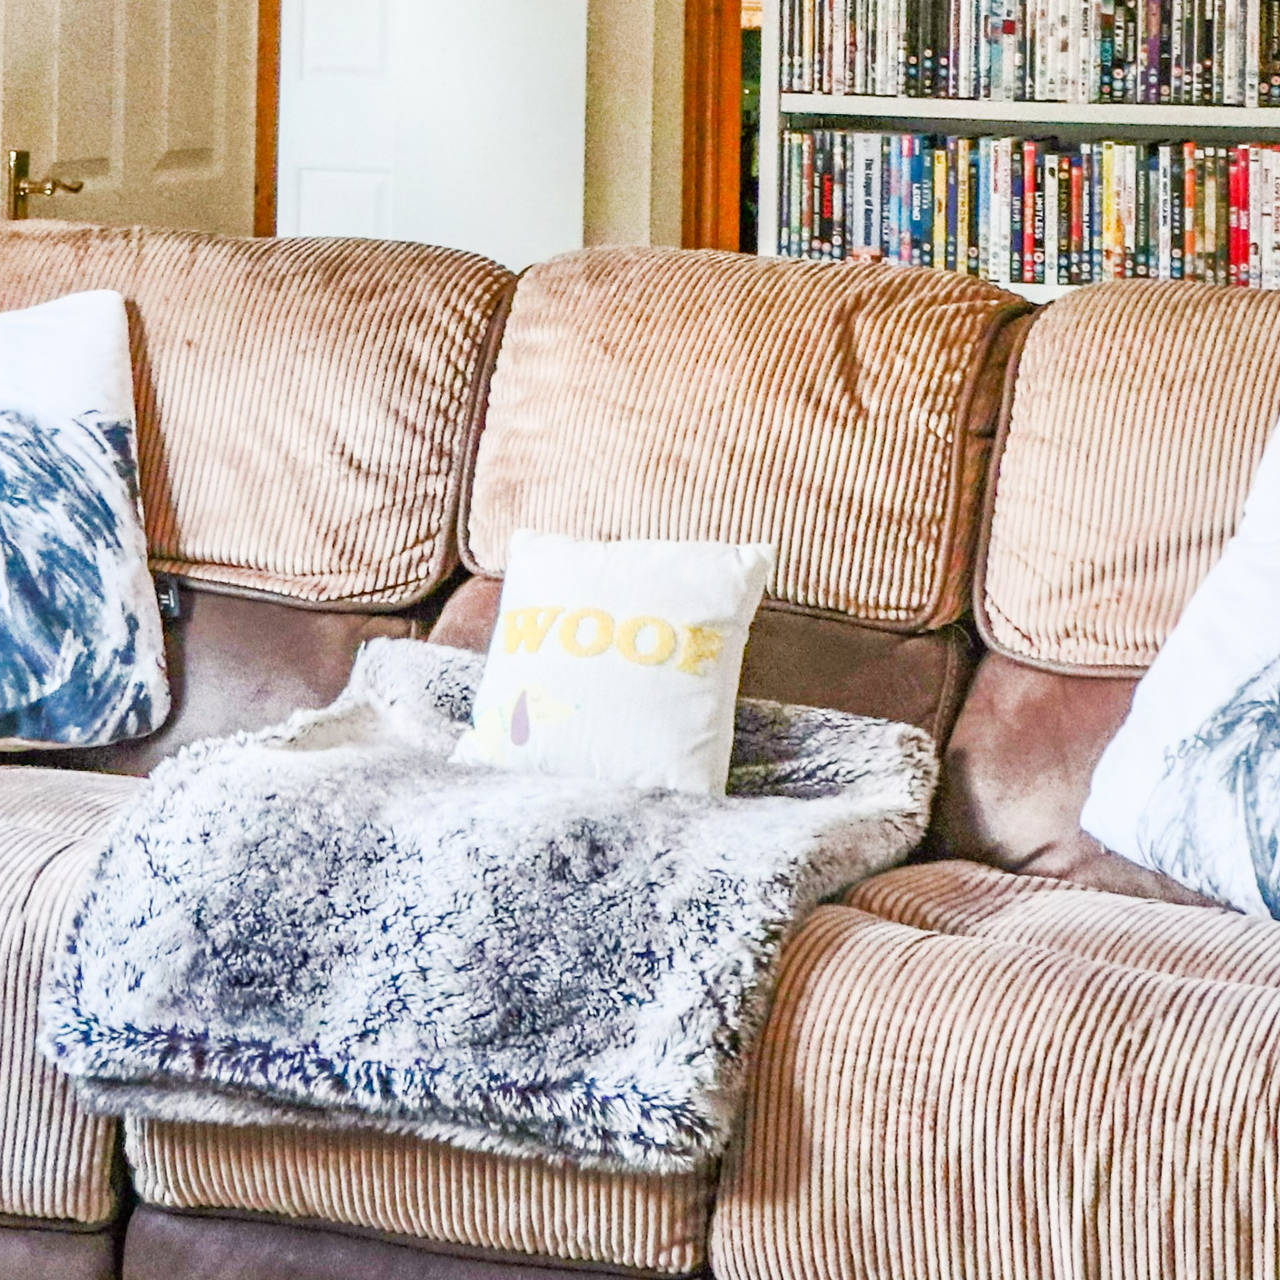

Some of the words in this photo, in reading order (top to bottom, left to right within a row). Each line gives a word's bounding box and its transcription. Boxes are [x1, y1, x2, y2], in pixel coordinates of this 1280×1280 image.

[823, 174, 832, 219] LAWLESS
[912, 183, 920, 221] LEGEND
[1034, 191, 1043, 239] LIMITLESS
[503, 606, 723, 677] WOOF
